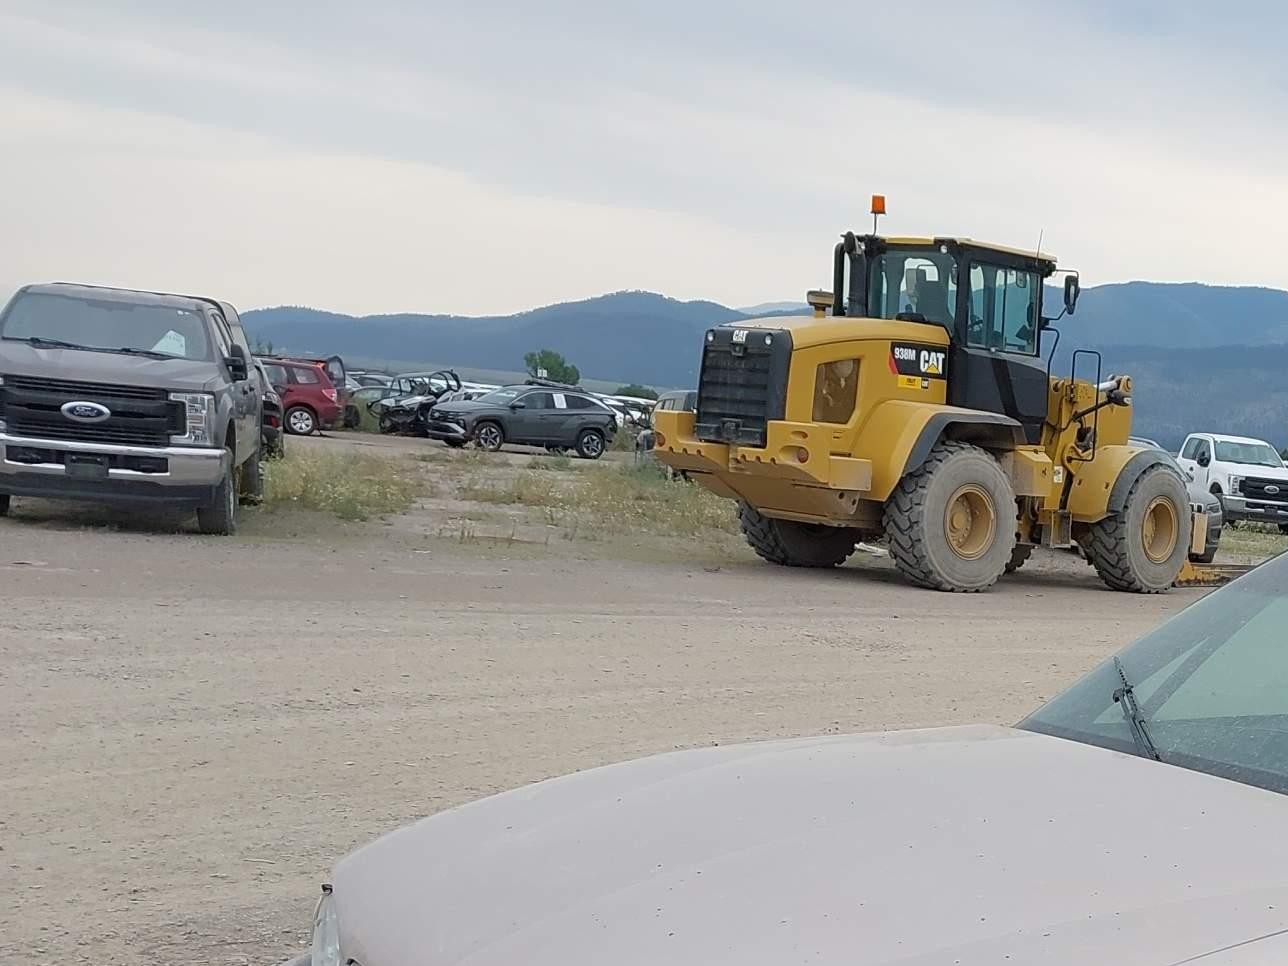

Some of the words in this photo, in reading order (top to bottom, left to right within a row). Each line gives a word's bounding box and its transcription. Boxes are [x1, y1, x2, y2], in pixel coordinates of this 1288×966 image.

[733, 330, 749, 343] CAT
[894, 347, 916, 361] 938M
[919, 350, 945, 374] CAT
